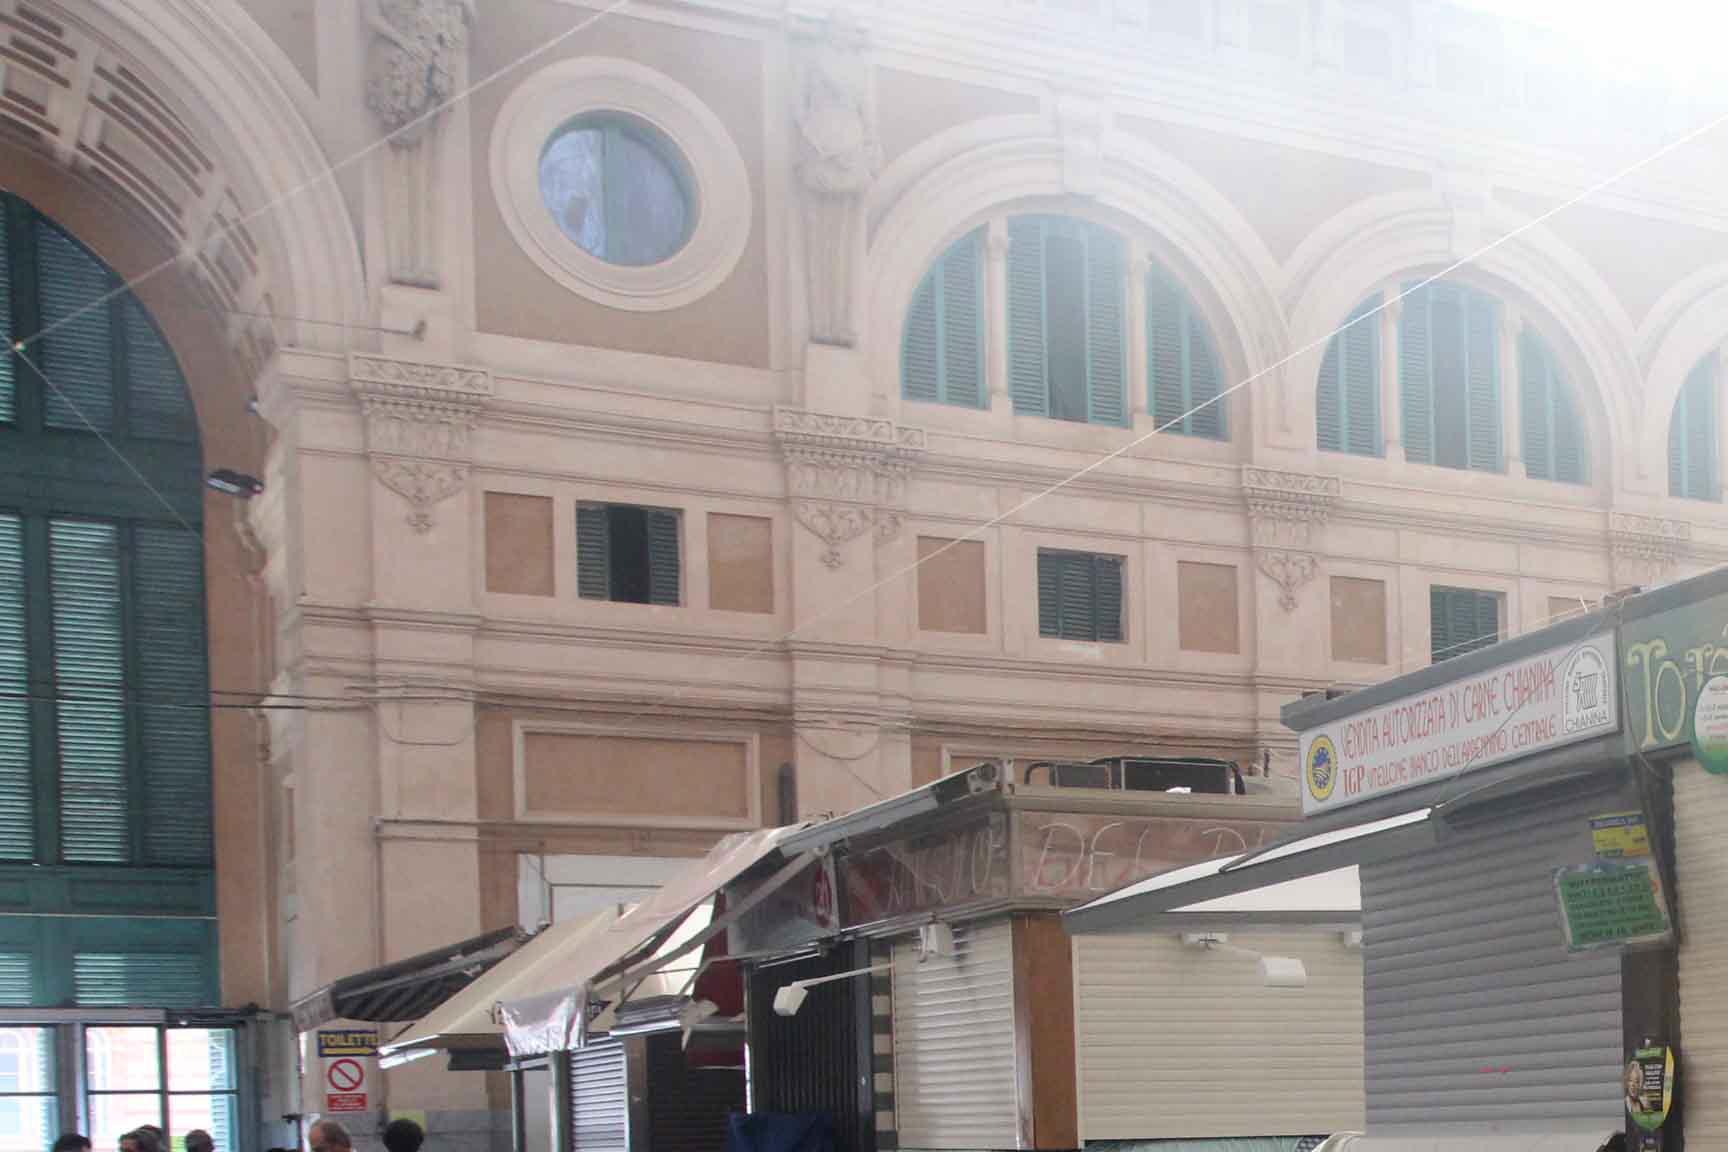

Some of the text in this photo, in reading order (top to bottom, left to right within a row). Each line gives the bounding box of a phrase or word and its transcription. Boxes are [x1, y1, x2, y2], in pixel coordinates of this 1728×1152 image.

[1381, 697, 1446, 751] AUTORIZZATA
[1449, 690, 1460, 728] DI
[1463, 676, 1501, 724] CARNE
[1503, 660, 1556, 713] CHIANINA
[1566, 709, 1610, 733] CHIANINA
[1343, 764, 1366, 797] IGP
